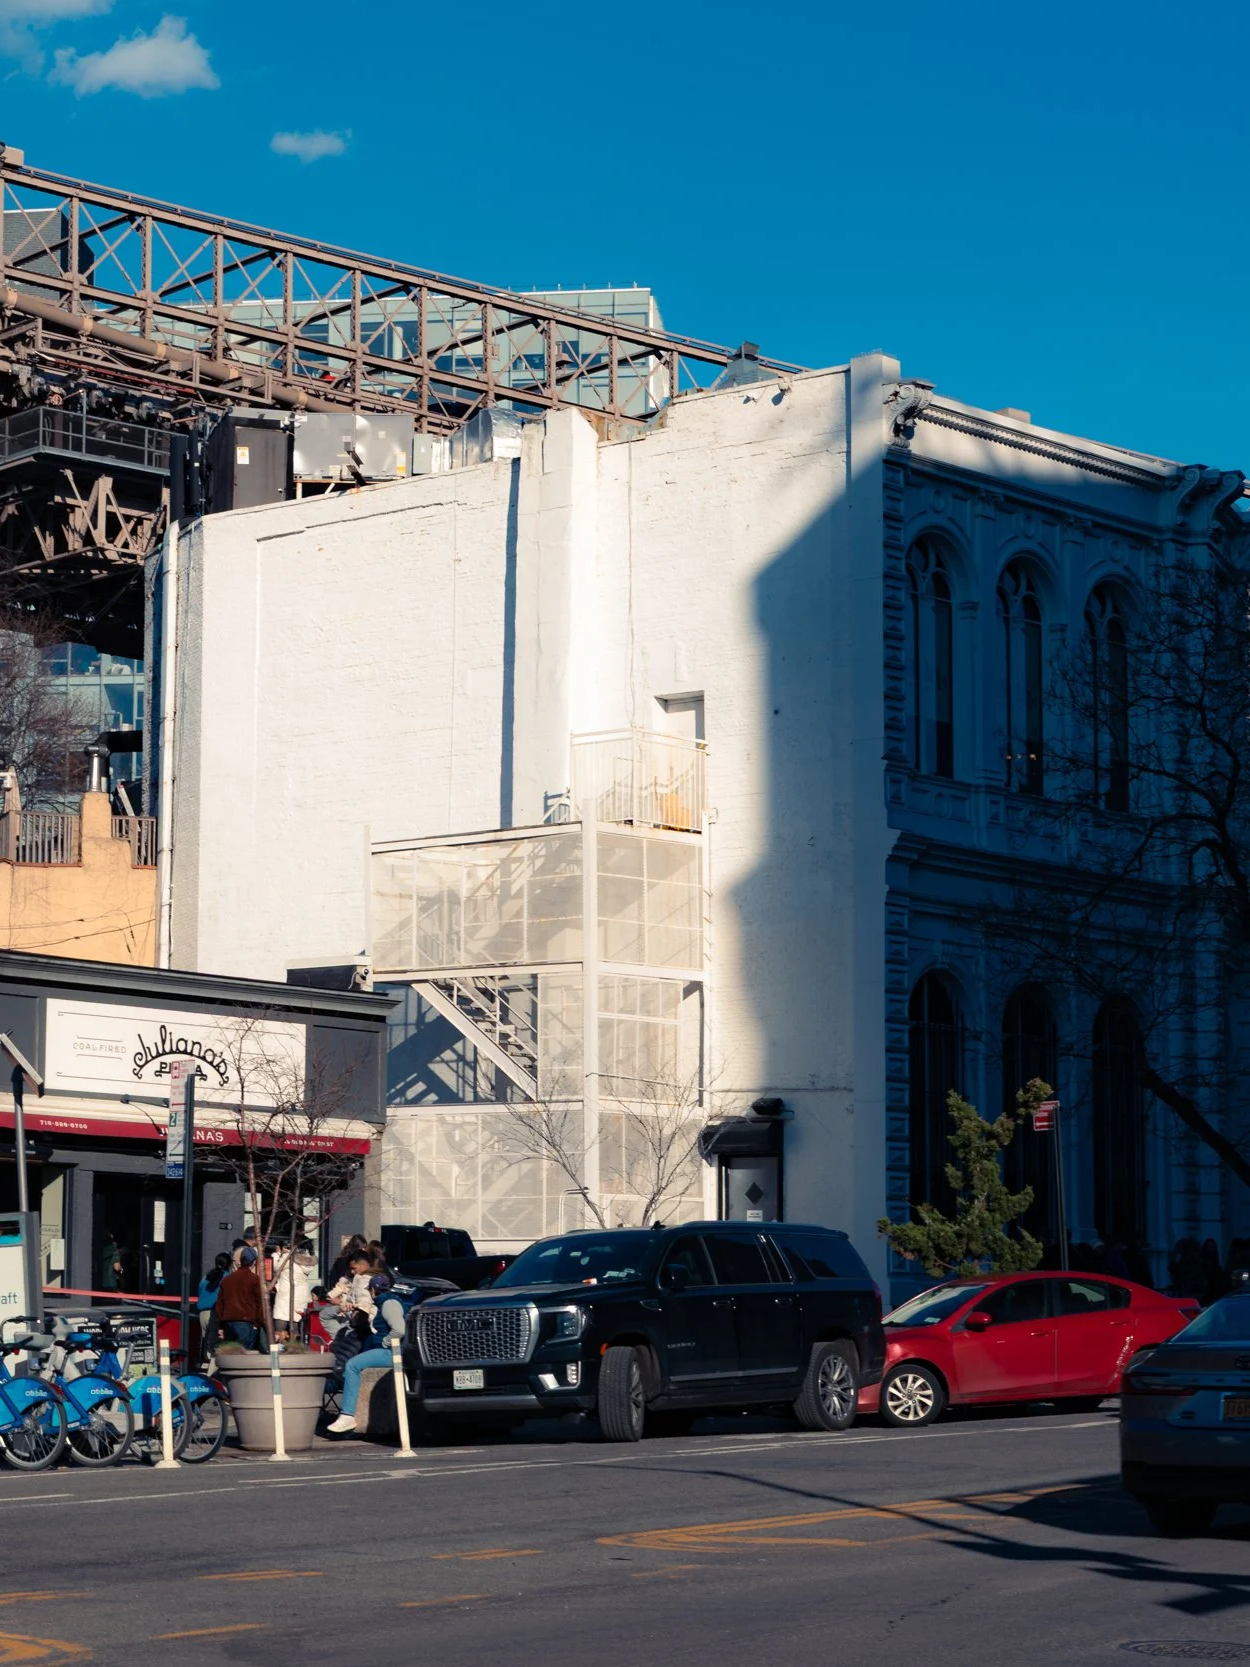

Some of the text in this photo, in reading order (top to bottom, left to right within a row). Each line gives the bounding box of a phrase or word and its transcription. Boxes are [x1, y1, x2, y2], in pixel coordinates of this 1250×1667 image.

[72, 1042, 127, 1054] COAL FIRED
[133, 1025, 228, 1080] Juliana's
[447, 1318, 494, 1331] GMC
